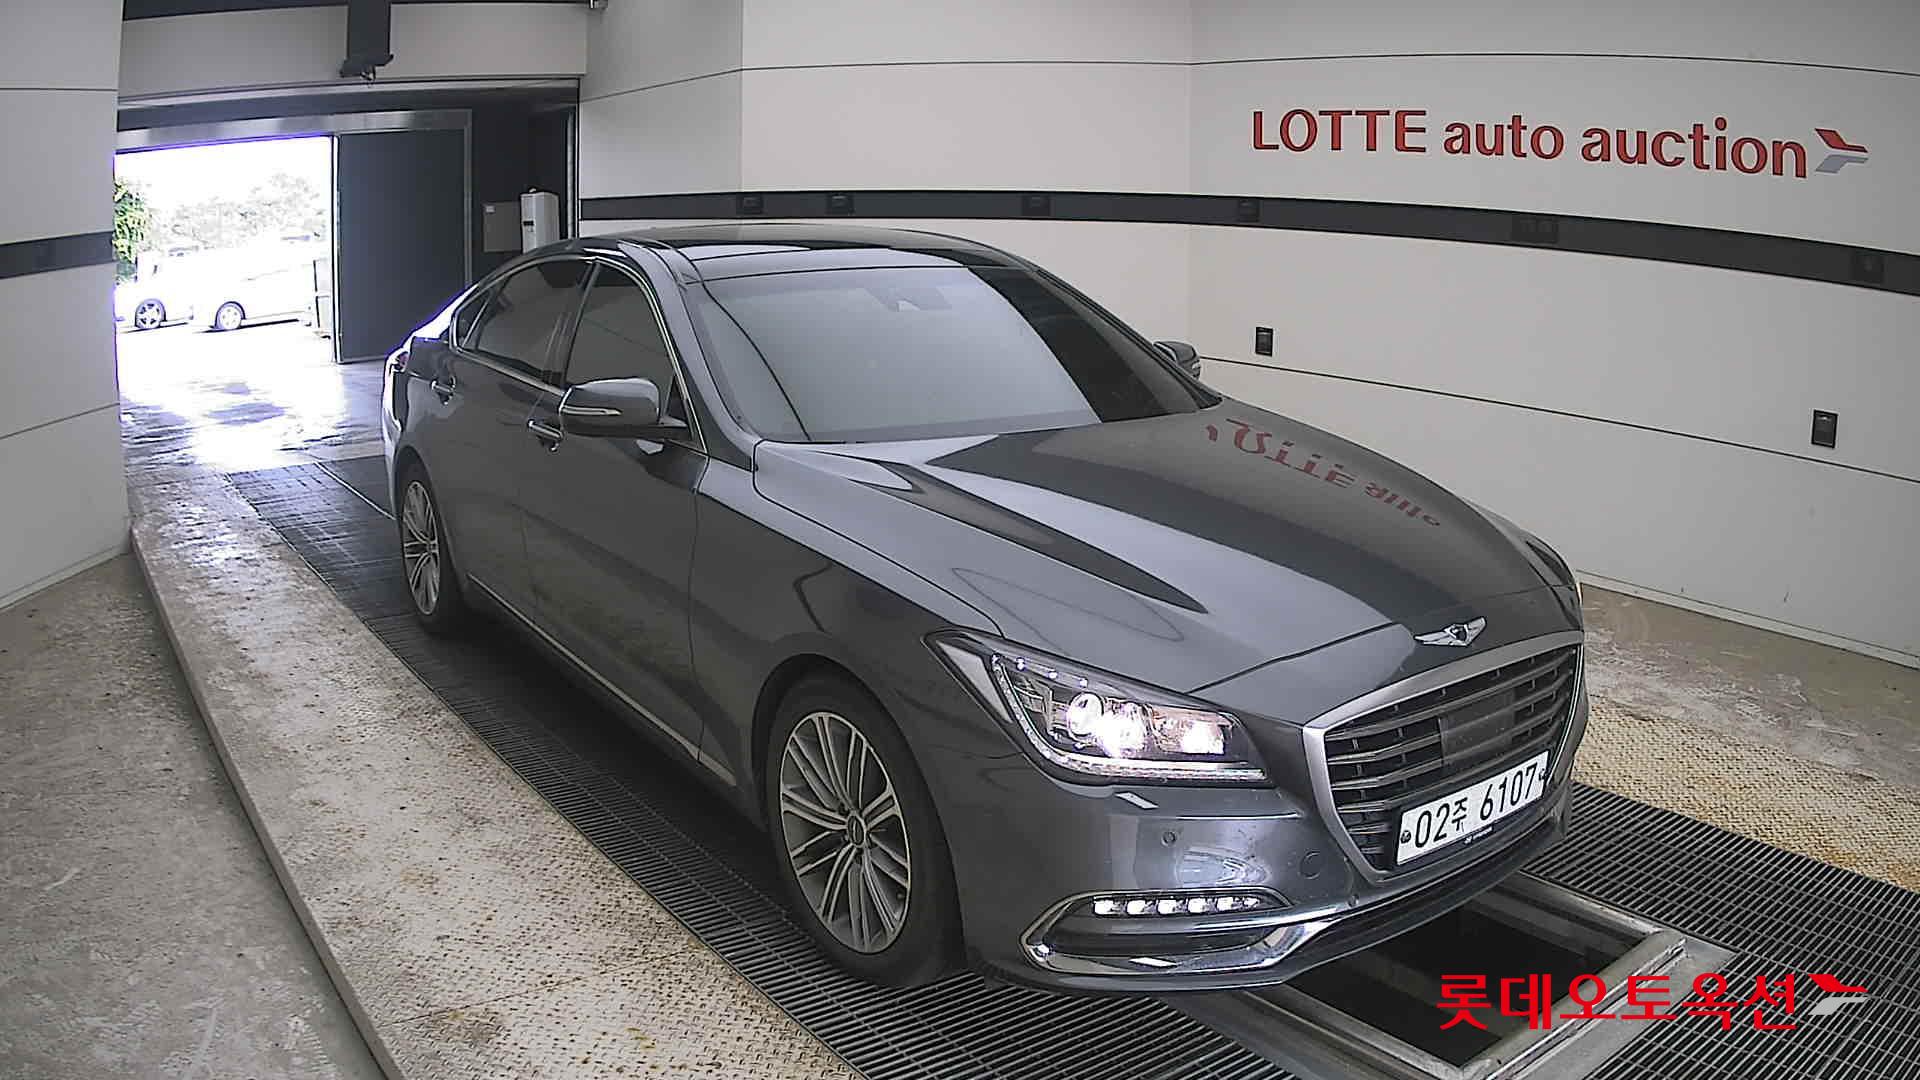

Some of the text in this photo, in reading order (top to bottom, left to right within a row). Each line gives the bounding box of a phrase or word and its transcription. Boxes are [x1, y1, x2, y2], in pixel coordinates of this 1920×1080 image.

[1253, 110, 1807, 178] LOTTE auto auction
[1414, 762, 1538, 848] 02주 6107
